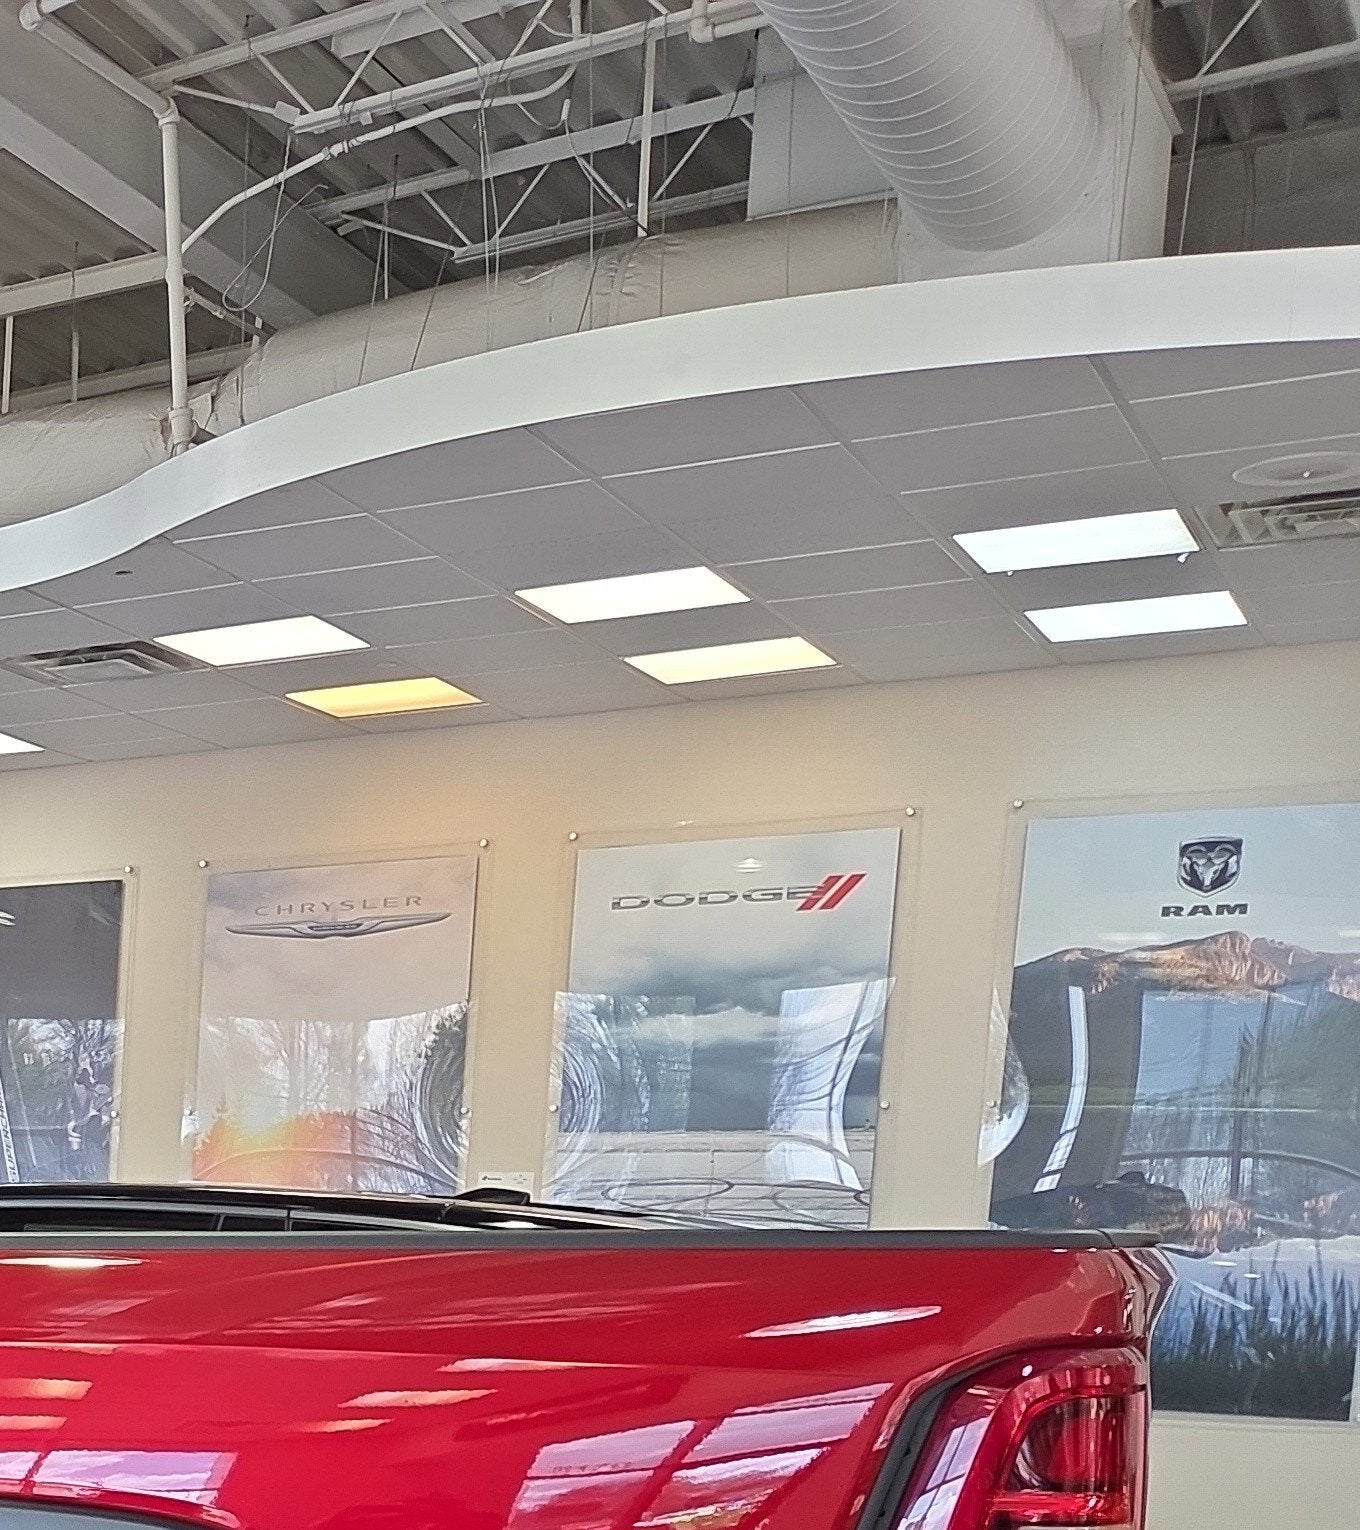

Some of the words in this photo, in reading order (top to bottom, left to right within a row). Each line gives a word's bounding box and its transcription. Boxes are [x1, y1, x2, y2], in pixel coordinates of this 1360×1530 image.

[254, 895, 422, 917] CHRYSLER
[611, 885, 828, 911] DODGE
[1160, 902, 1249, 918] RAM
